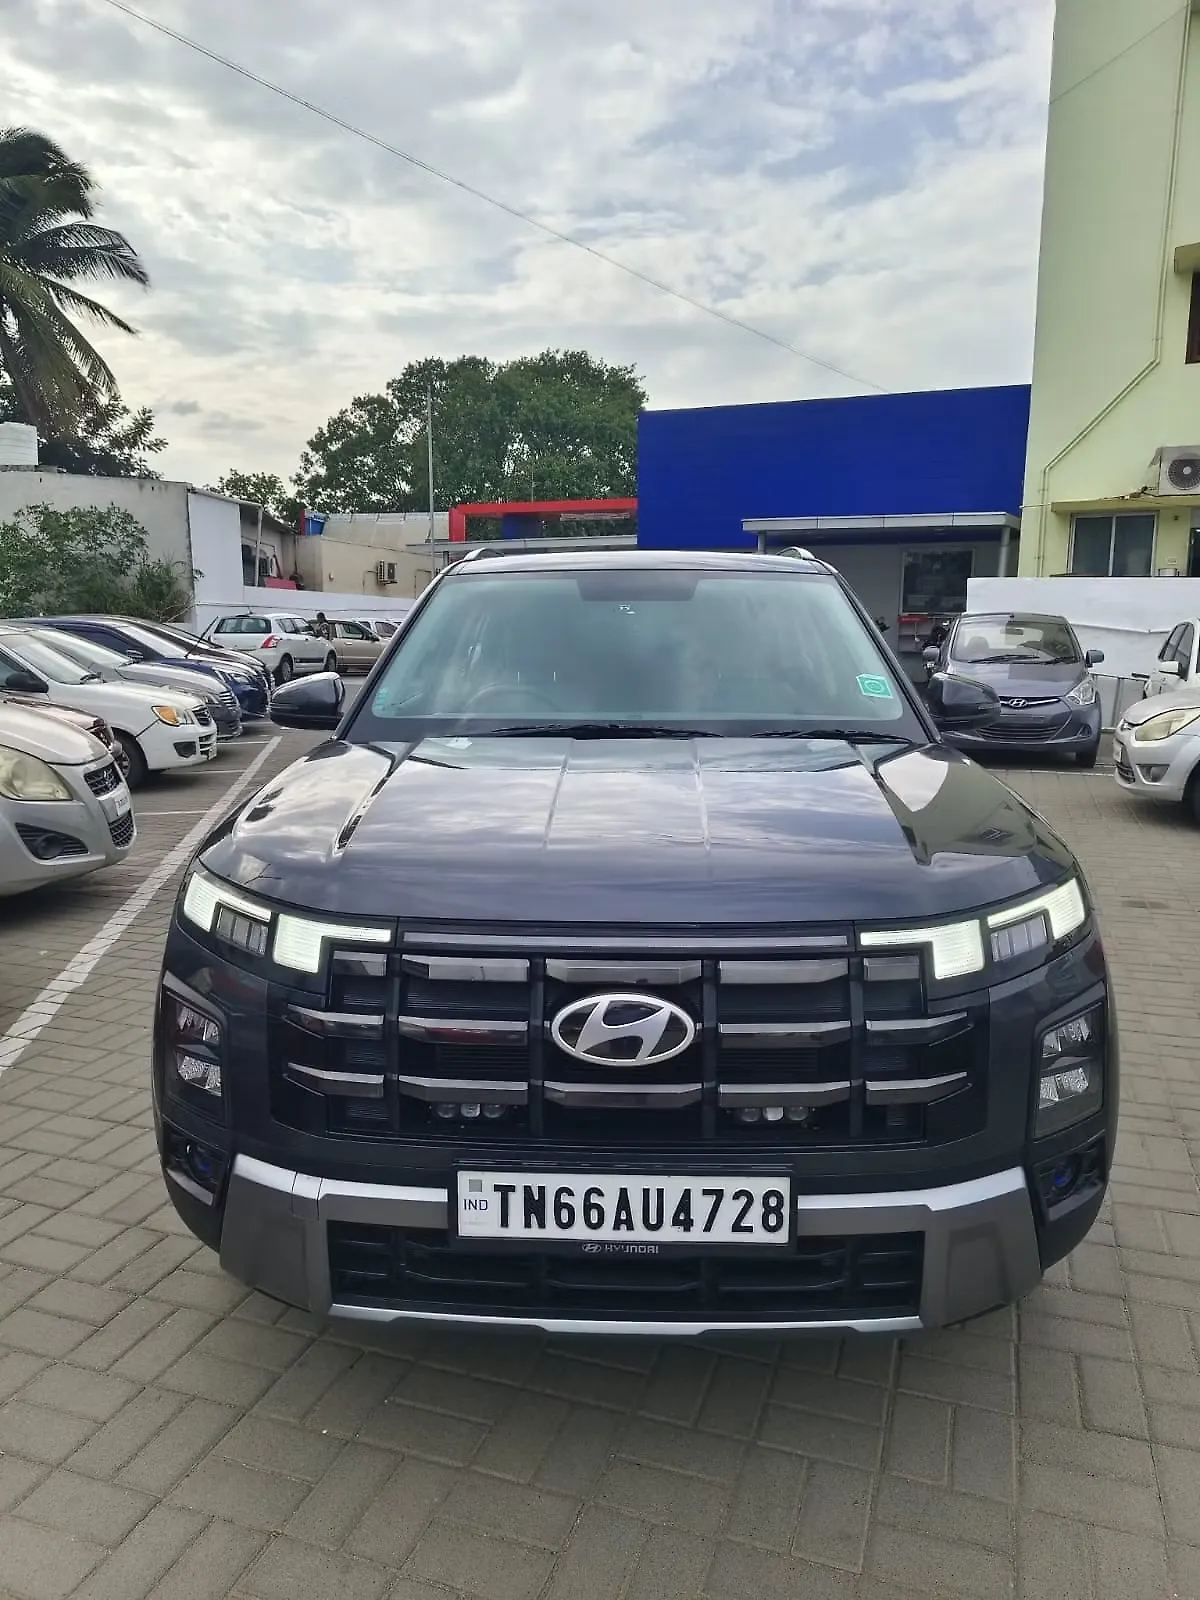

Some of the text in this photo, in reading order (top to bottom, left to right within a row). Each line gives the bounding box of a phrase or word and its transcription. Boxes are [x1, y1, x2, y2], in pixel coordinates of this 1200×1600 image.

[463, 1199, 488, 1211] IND
[494, 1184, 784, 1233] TN66AU4728
[604, 1243, 659, 1254] HYUNDAI
